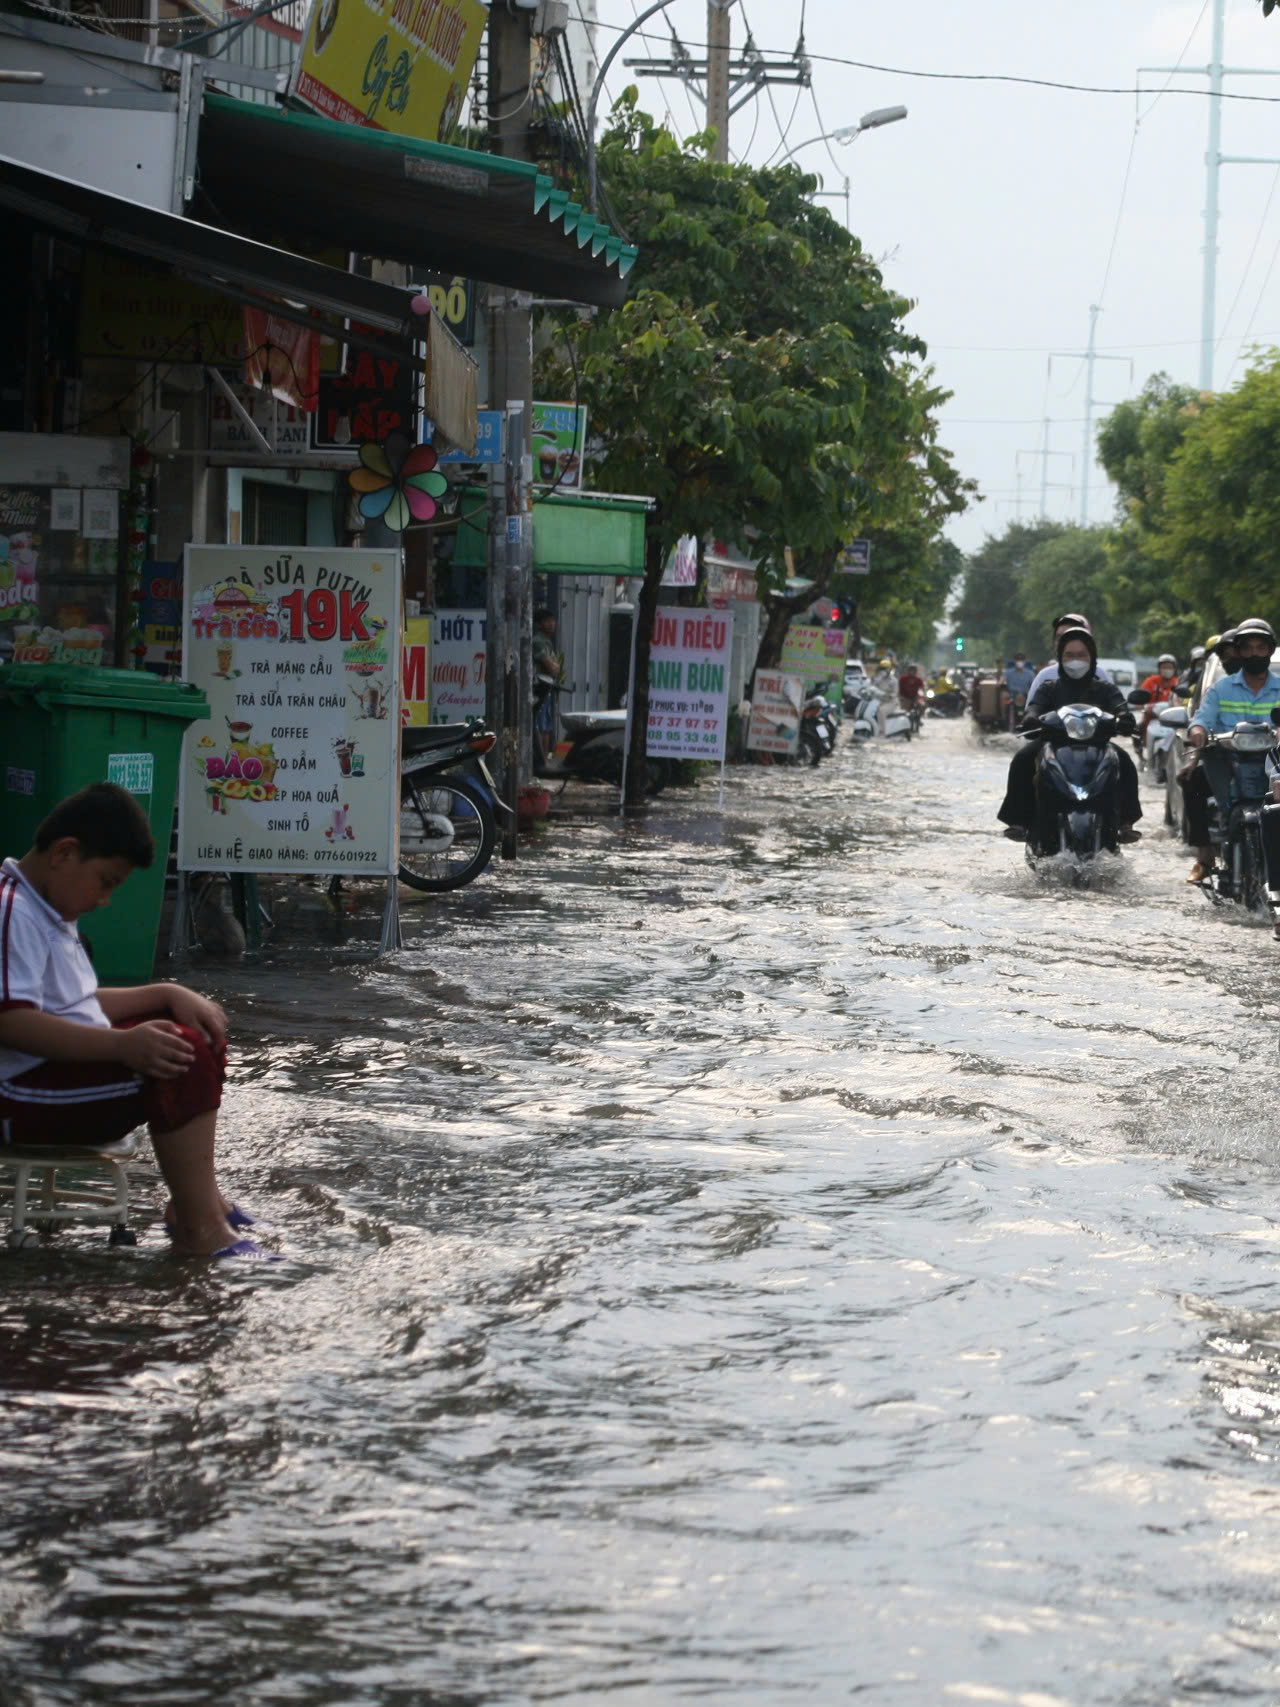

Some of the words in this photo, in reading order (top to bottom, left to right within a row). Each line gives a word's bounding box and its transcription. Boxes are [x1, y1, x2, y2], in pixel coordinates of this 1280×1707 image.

[227, 424, 267, 441] BÁH
[263, 554, 305, 586] SỮA
[315, 566, 373, 602] PUTIN
[0, 582, 39, 607] oda
[441, 614, 474, 641] HỚT
[650, 611, 677, 647] ÚN
[682, 614, 726, 650] RIÊU
[648, 659, 682, 691] ANH
[687, 657, 724, 693] BÚN
[260, 688, 283, 707] SỮA
[271, 727, 309, 739] COFFEE
[292, 789, 312, 802] HOA
[317, 784, 340, 803] QUẢ
[267, 819, 291, 831] SINH
[198, 846, 222, 859] LIÊN
[226, 837, 243, 862] HỆ
[248, 847, 273, 860] GIAO
[314, 850, 378, 862] 0776601922
